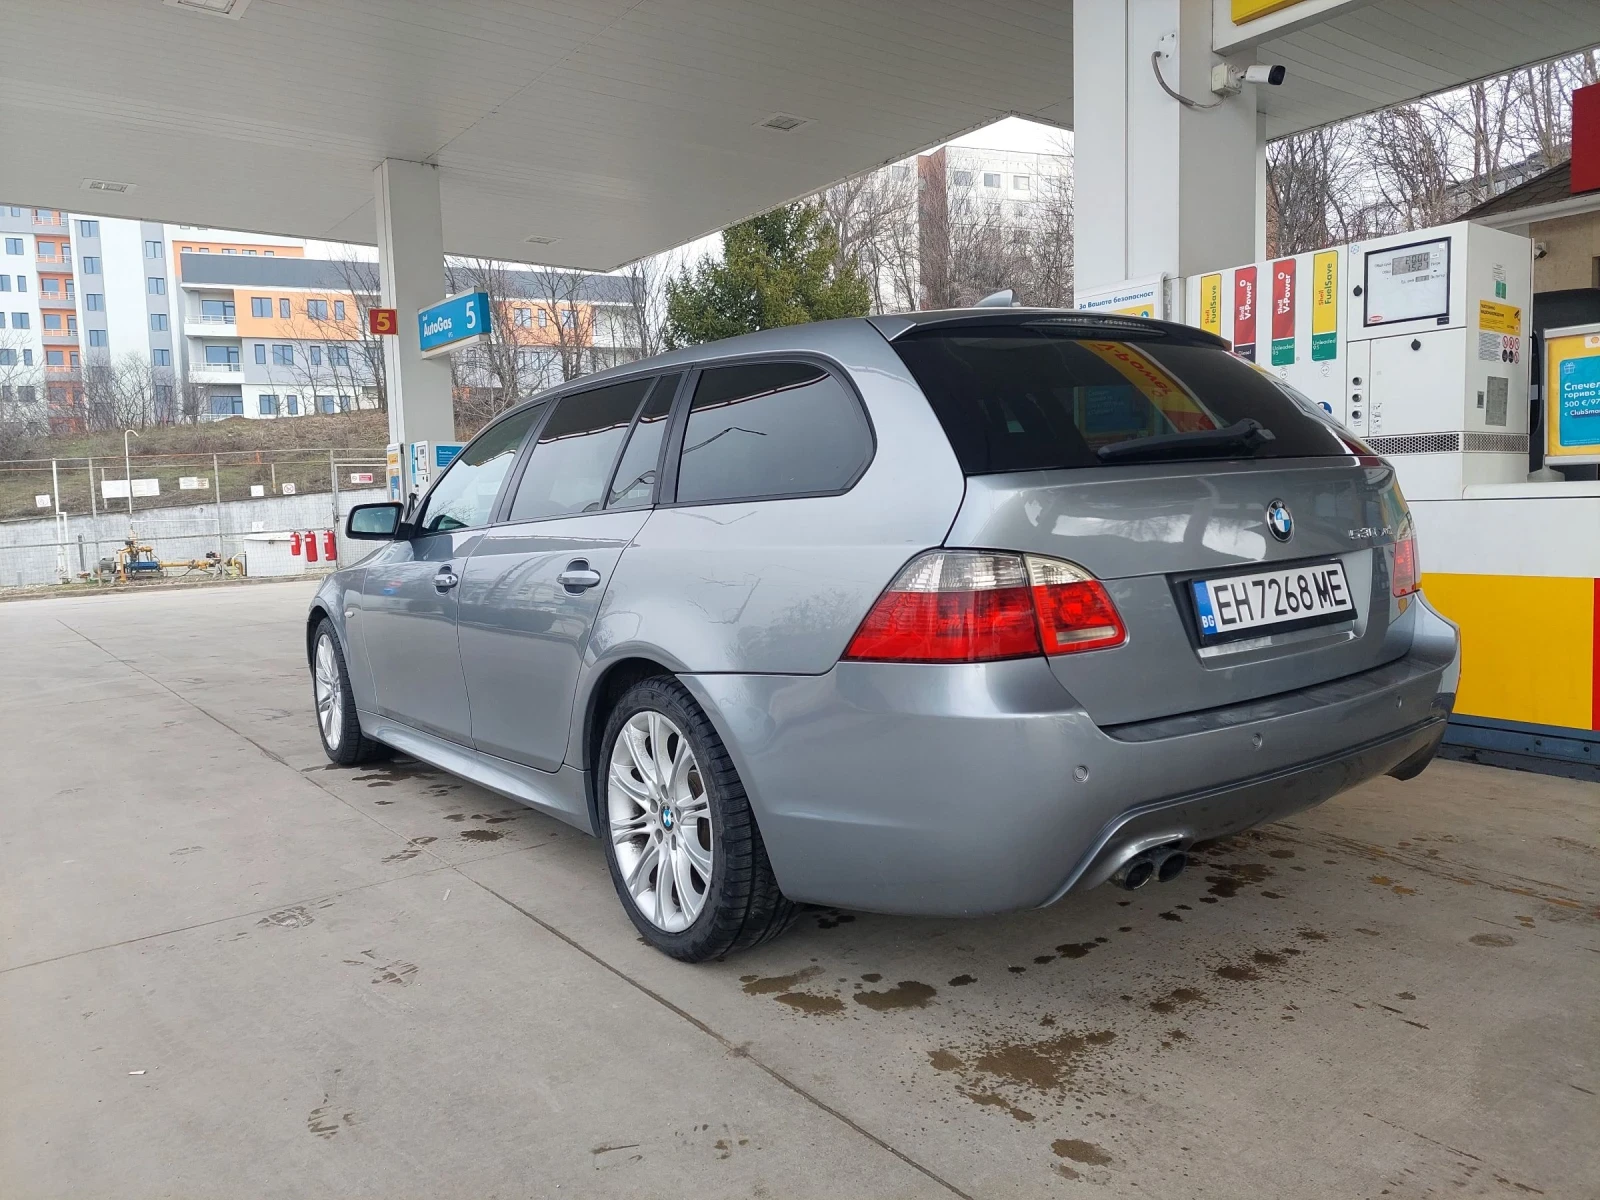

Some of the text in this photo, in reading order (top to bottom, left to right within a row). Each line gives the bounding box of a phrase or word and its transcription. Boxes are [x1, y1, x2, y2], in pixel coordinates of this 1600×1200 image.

[1324, 263, 1332, 305] FuelSave
[1087, 299, 1112, 308] Вашата
[1113, 291, 1154, 304] безопасност
[1244, 281, 1252, 320] V-Power
[1283, 274, 1291, 314] V-Power
[376, 312, 391, 331] 5
[465, 301, 476, 329] 5
[423, 316, 453, 338] AutoGas
[1312, 338, 1336, 346] Unleaded
[1564, 391, 1596, 399] гориво
[1564, 400, 1580, 408] 500
[1201, 615, 1215, 629] BG
